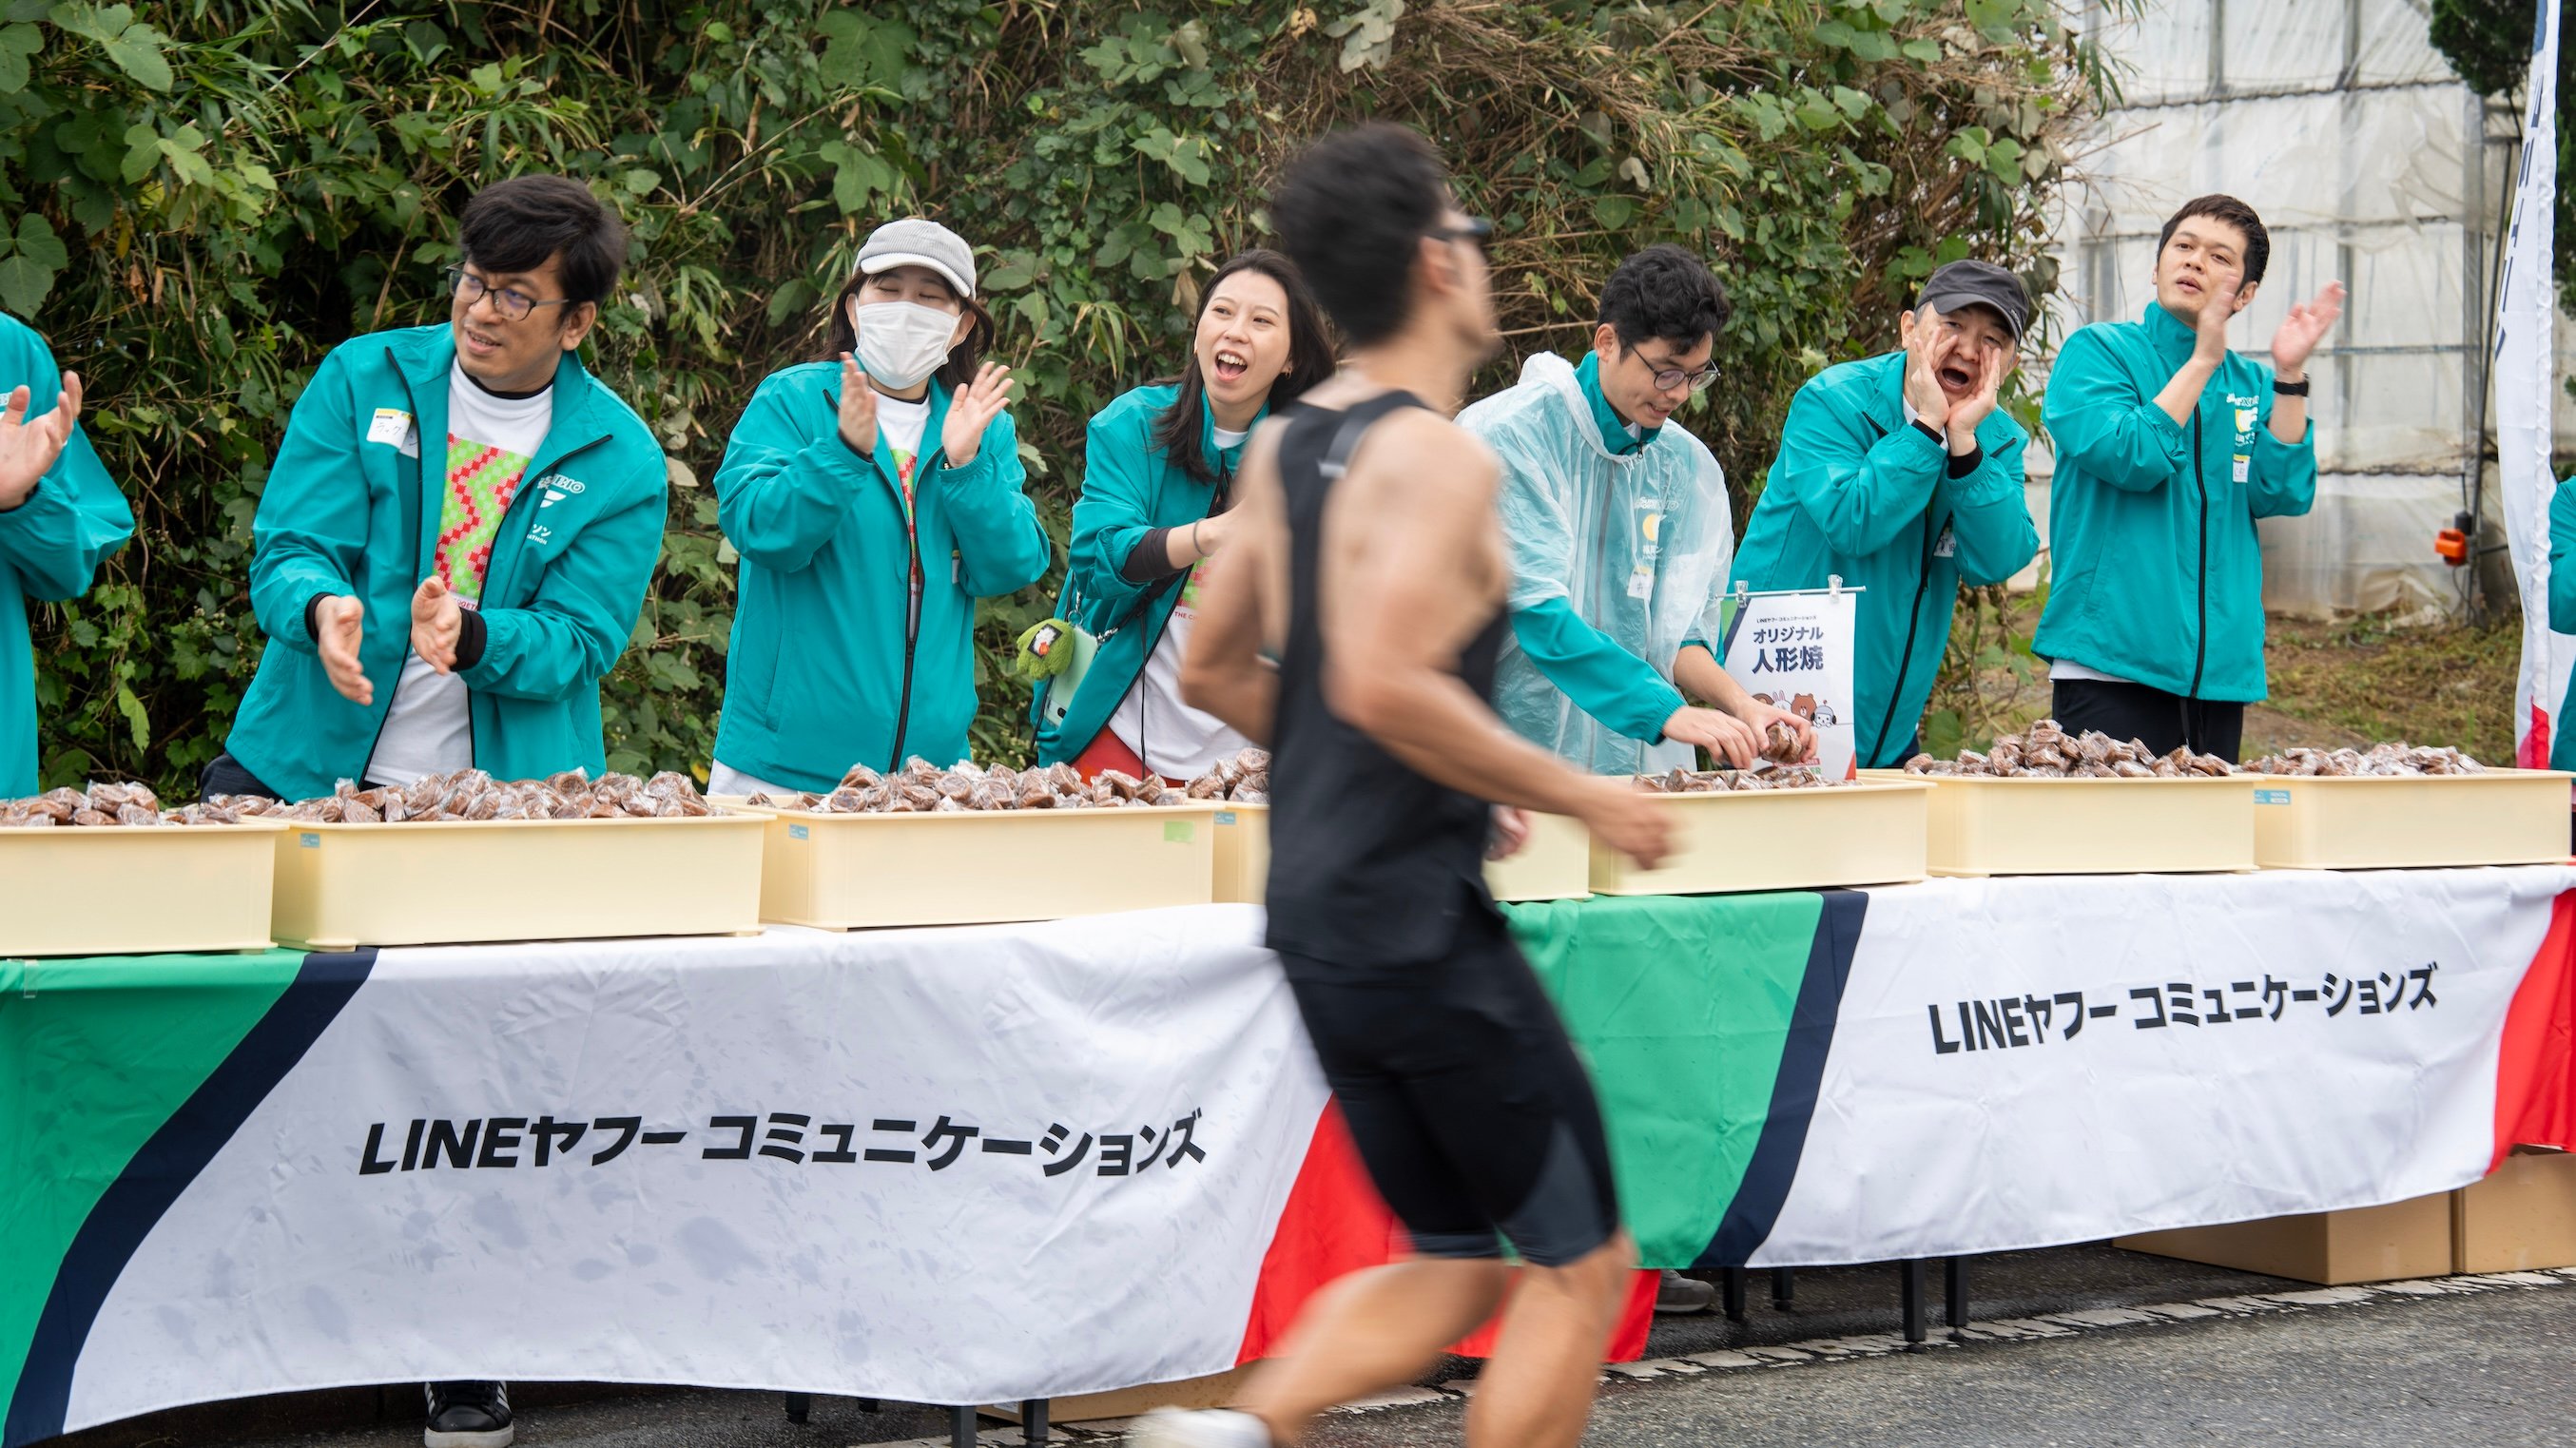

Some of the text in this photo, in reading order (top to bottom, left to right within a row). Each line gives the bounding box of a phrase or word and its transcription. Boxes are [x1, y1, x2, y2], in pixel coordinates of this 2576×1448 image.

[1753, 626, 1825, 645] オリジナル
[1753, 646, 1824, 674] 人形焼
[1928, 960, 2439, 1054] LINEヤフー コミュニケーションズ
[358, 1108, 1206, 1177] LINEヤフー コミュニケーションズ
